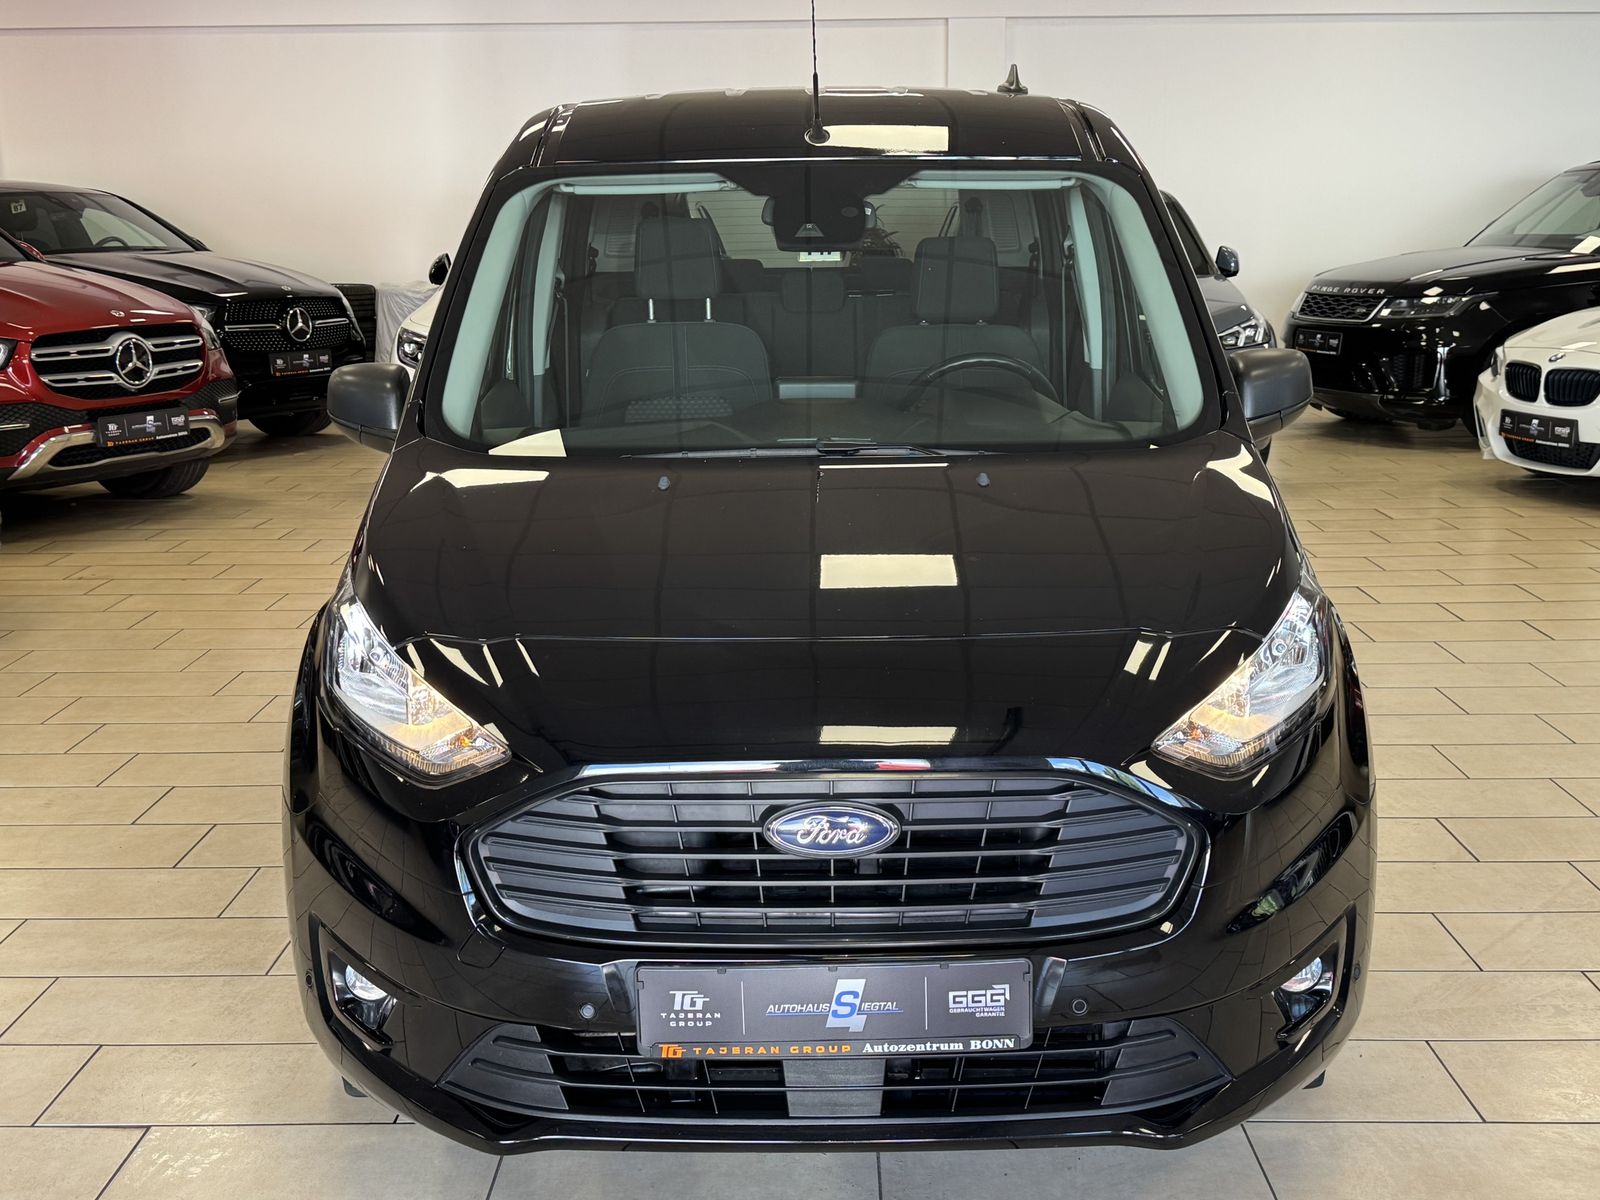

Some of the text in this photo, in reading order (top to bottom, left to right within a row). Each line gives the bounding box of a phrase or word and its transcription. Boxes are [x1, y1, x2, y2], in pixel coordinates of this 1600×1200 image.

[1343, 287, 1385, 295] ROVER
[797, 815, 868, 844] Ford
[669, 990, 710, 1010] TG
[948, 989, 1005, 1008] GGG
[766, 1003, 831, 1014] AUTOHAUS
[949, 1006, 1006, 1014] GEBRAUCHTWAGEN
[692, 1046, 780, 1055] TAJERAN
[789, 1045, 852, 1054] GROUP
[862, 1041, 964, 1054] Autozentrum
[969, 1038, 1015, 1050] BONN
